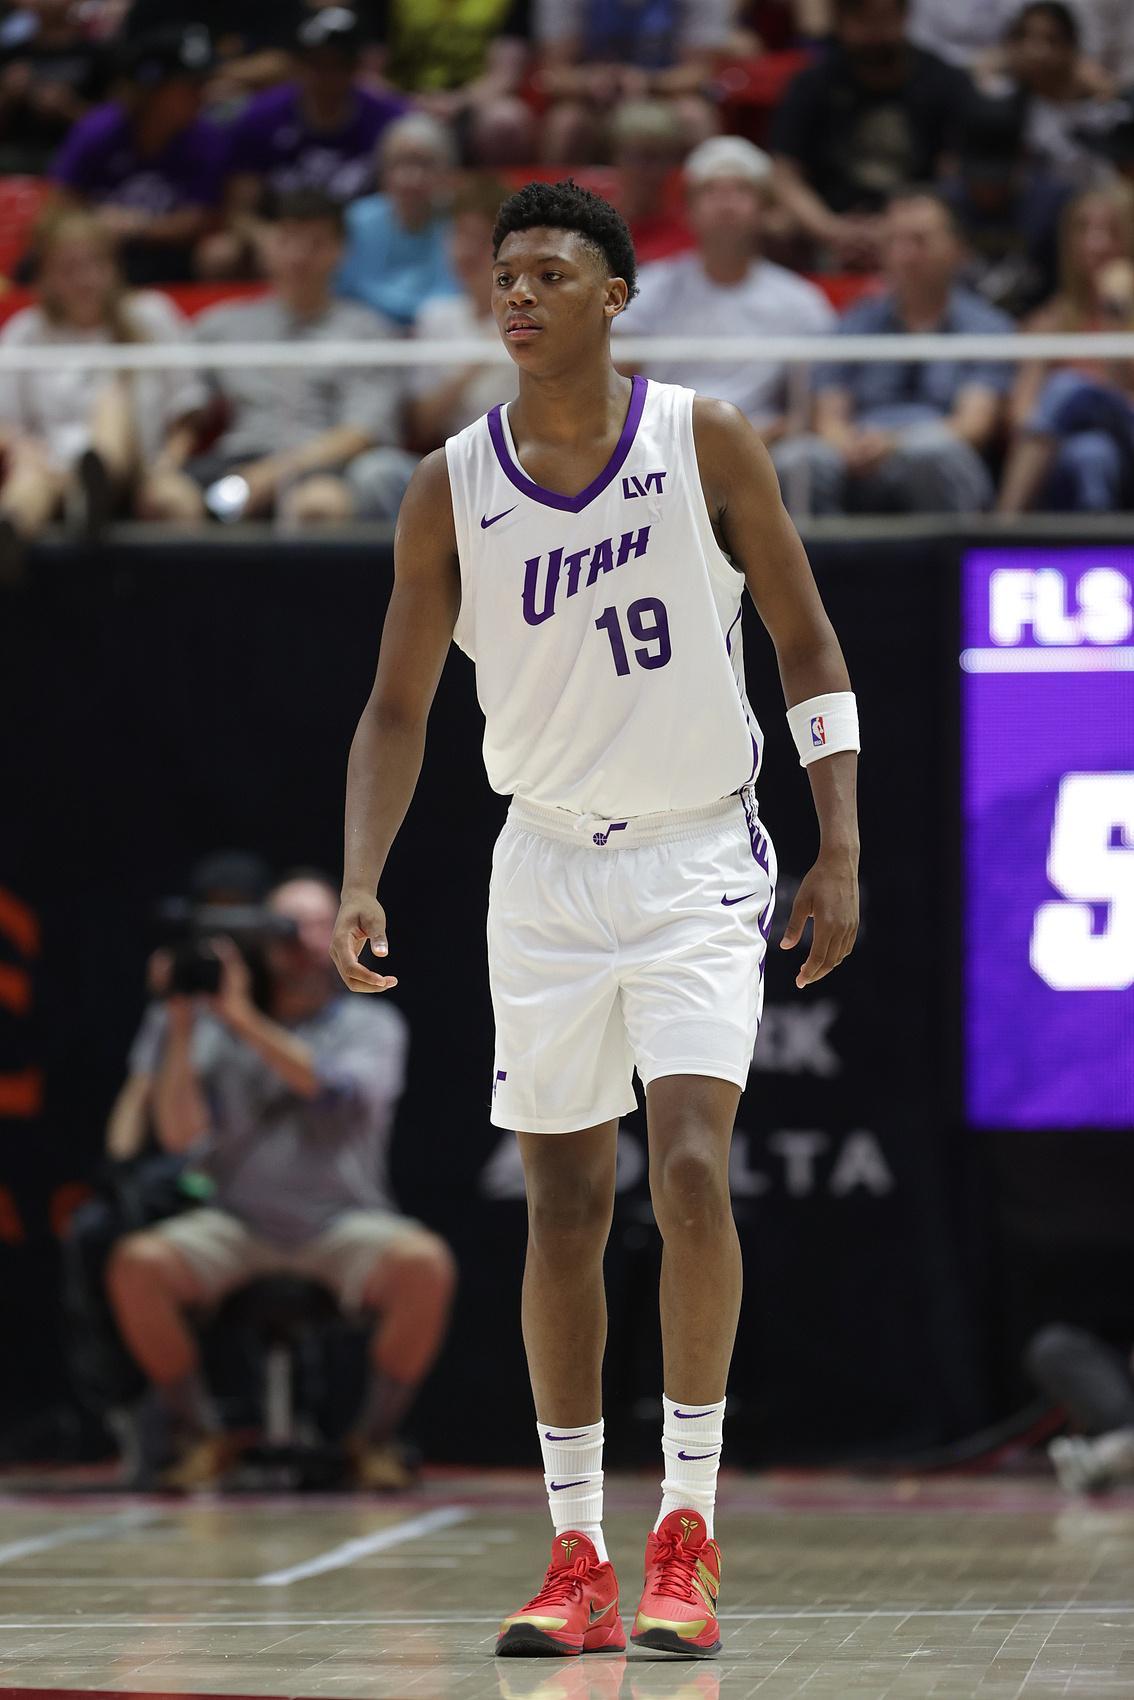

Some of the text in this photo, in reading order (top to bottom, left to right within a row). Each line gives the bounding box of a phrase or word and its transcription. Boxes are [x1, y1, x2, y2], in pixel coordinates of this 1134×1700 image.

[622, 471, 667, 500] LVT
[521, 525, 651, 627] UTAH
[989, 567, 1133, 646] FLS
[595, 596, 672, 677] 19
